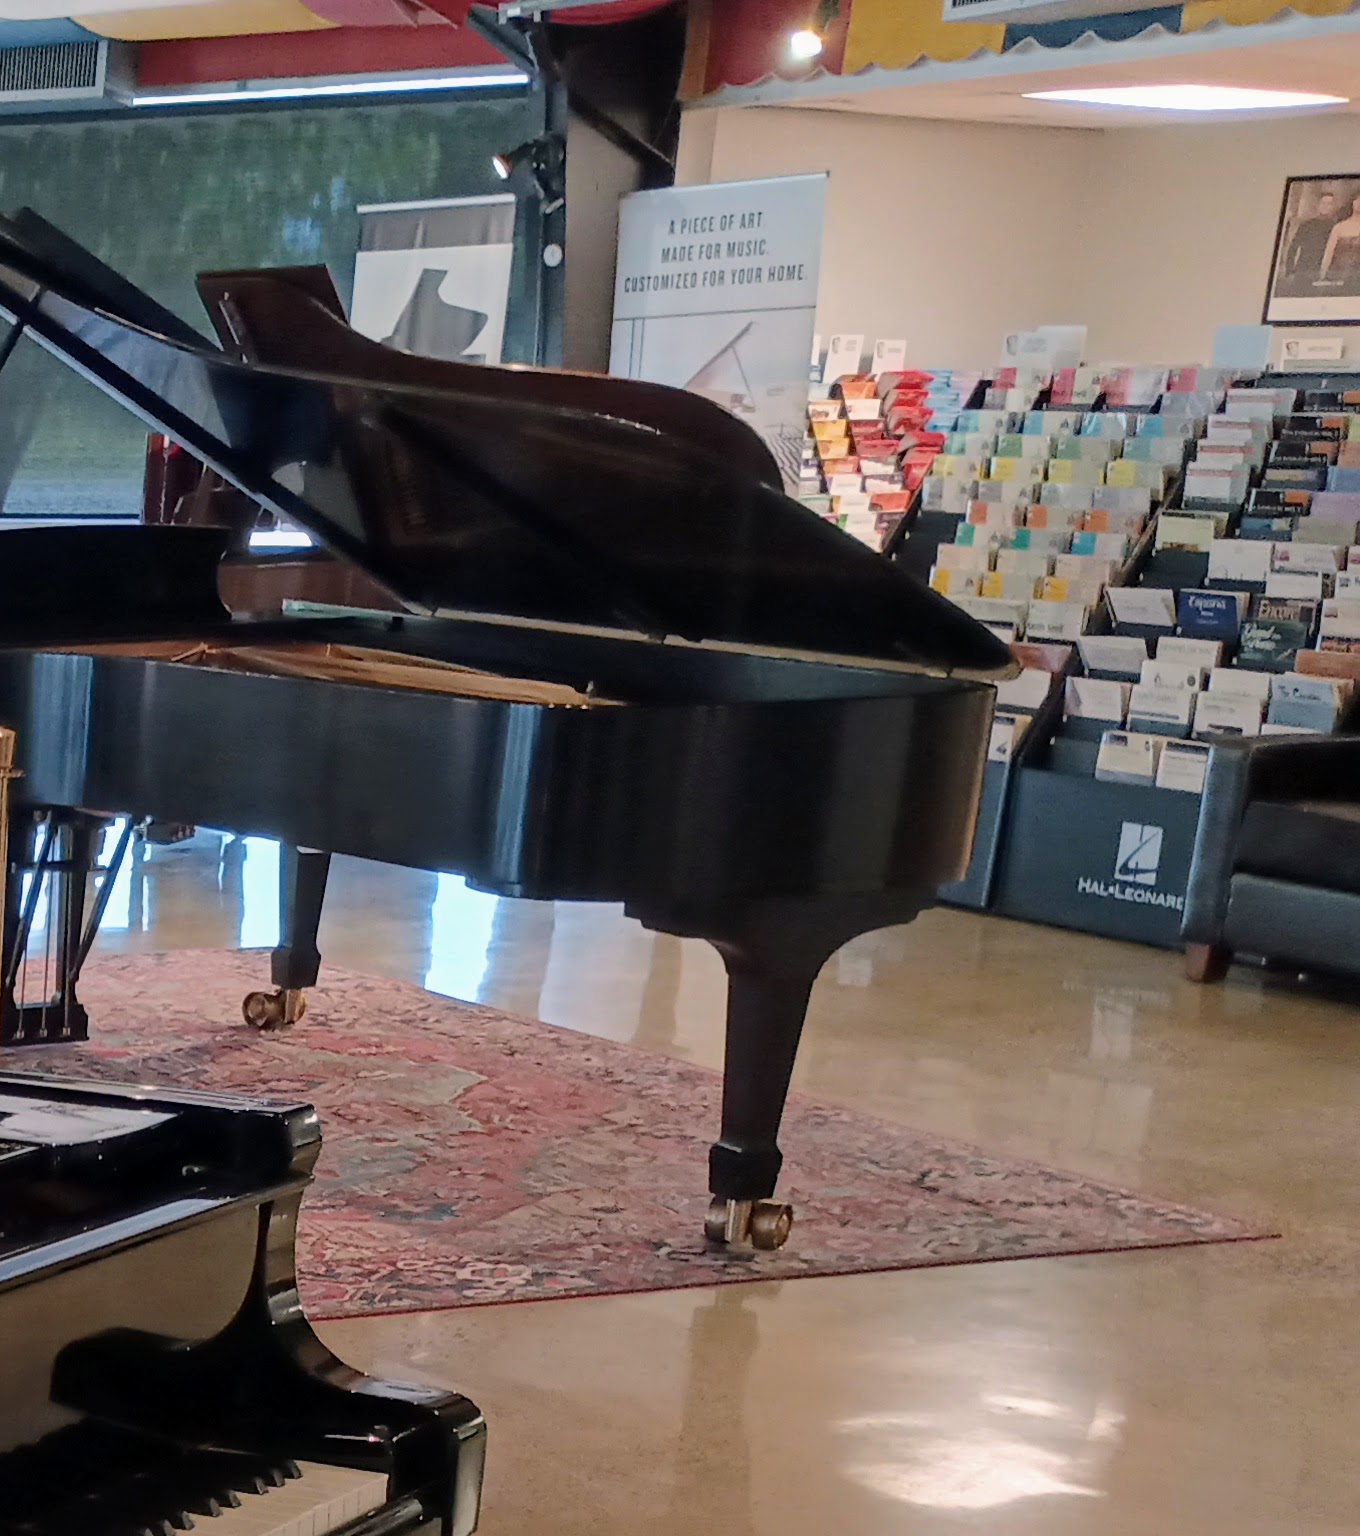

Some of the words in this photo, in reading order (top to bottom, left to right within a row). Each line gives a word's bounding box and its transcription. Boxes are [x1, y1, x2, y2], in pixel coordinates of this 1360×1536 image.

[668, 220, 675, 235] A
[680, 216, 715, 234] PIECE
[720, 214, 734, 231] OF
[661, 244, 694, 263] MADE
[698, 242, 721, 260] FOR
[624, 271, 697, 293] CUSTOMIZED
[702, 269, 725, 287] FOR
[731, 266, 762, 285] YOUR
